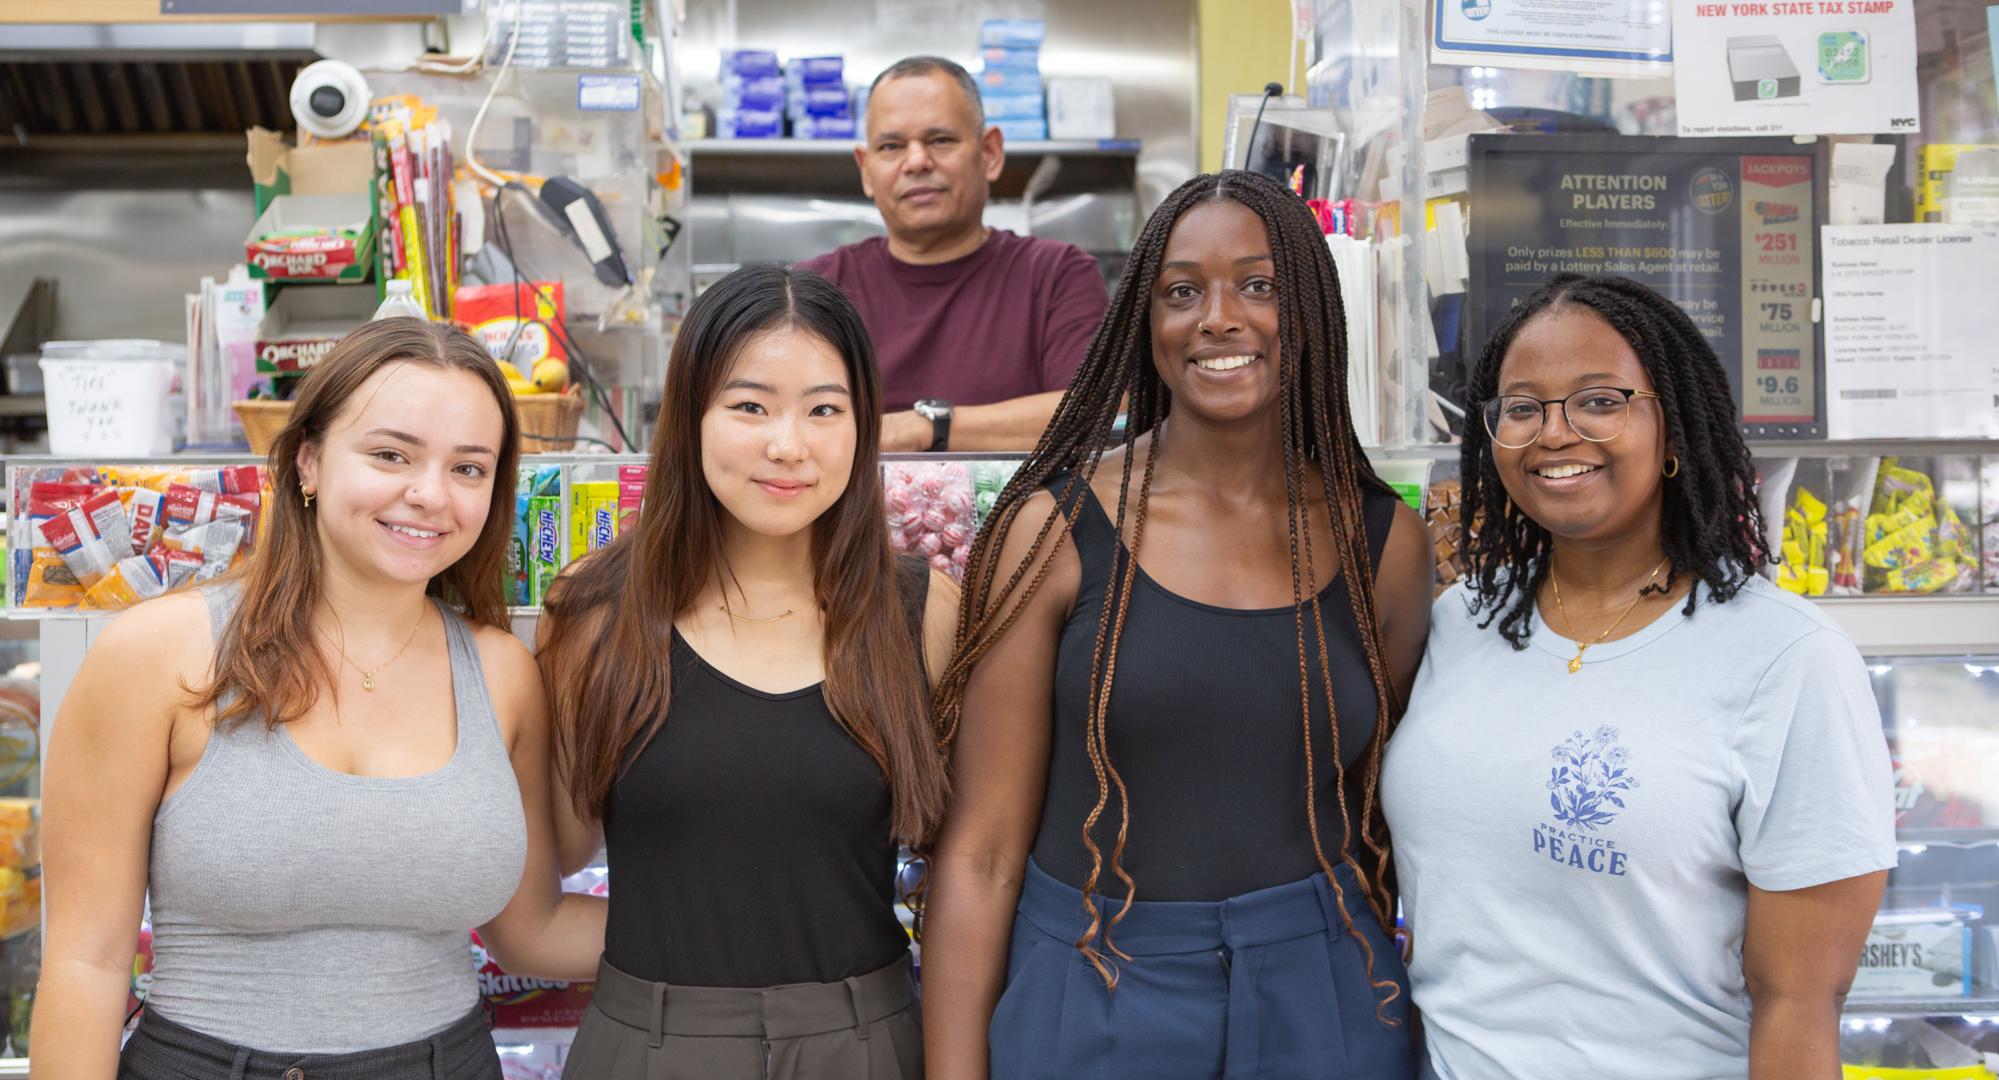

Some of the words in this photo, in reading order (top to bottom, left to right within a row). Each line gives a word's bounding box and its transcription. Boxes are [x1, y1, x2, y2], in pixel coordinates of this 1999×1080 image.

[1696, 4, 1726, 17] NEW
[1732, 3, 1768, 16] YORK
[1772, 2, 1813, 15] STATE
[1818, 1, 1843, 14] TAX
[1848, 0, 1893, 14] STAMP
[1891, 118, 1916, 127] NYC
[1747, 164, 1808, 175] JACKPOTS
[1560, 174, 1667, 190] ATTENTION
[1572, 194, 1655, 210] PLAYERS
[1560, 218, 1602, 229] Effective
[1755, 233, 1797, 251] $251
[1830, 237, 1871, 247] Tobacco
[1873, 235, 1900, 245] Retail
[1903, 235, 1934, 244] Dealer
[1937, 234, 1972, 244] License
[253, 252, 328, 270] ORCHARD
[1508, 247, 1536, 260] Only
[1538, 247, 1573, 260] prizes
[1575, 247, 1604, 258] LESS
[1607, 247, 1641, 258] THAN
[1643, 247, 1675, 259] $600
[1680, 249, 1704, 261] may
[1705, 248, 1720, 258] be
[1758, 254, 1800, 264] MILLION
[288, 264, 313, 276] BAR
[1506, 261, 1531, 273] paid
[1533, 261, 1548, 273] by
[1550, 263, 1558, 272] a
[1560, 261, 1602, 273] Lottery
[1604, 261, 1636, 272] Sales
[1638, 262, 1672, 274] Agent
[1675, 263, 1686, 272] at
[1689, 262, 1722, 273] retail.
[1679, 299, 1701, 310] may
[1703, 297, 1718, 309] be
[1760, 303, 1792, 320] $75
[1689, 313, 1725, 324] ervice
[1759, 323, 1800, 332] MILLION
[1757, 376, 1799, 394] $9.6
[67, 398, 123, 416] THANK
[1760, 396, 1801, 406] MILLION
[539, 510, 554, 564] HI-CHEW
[596, 509, 611, 549] HI-CHE
[513, 542, 521, 571] BLACK
[1540, 822, 1616, 849] PRACTICE
[1533, 827, 1628, 877] PEACE
[1859, 943, 1922, 968] RSHEY'S
